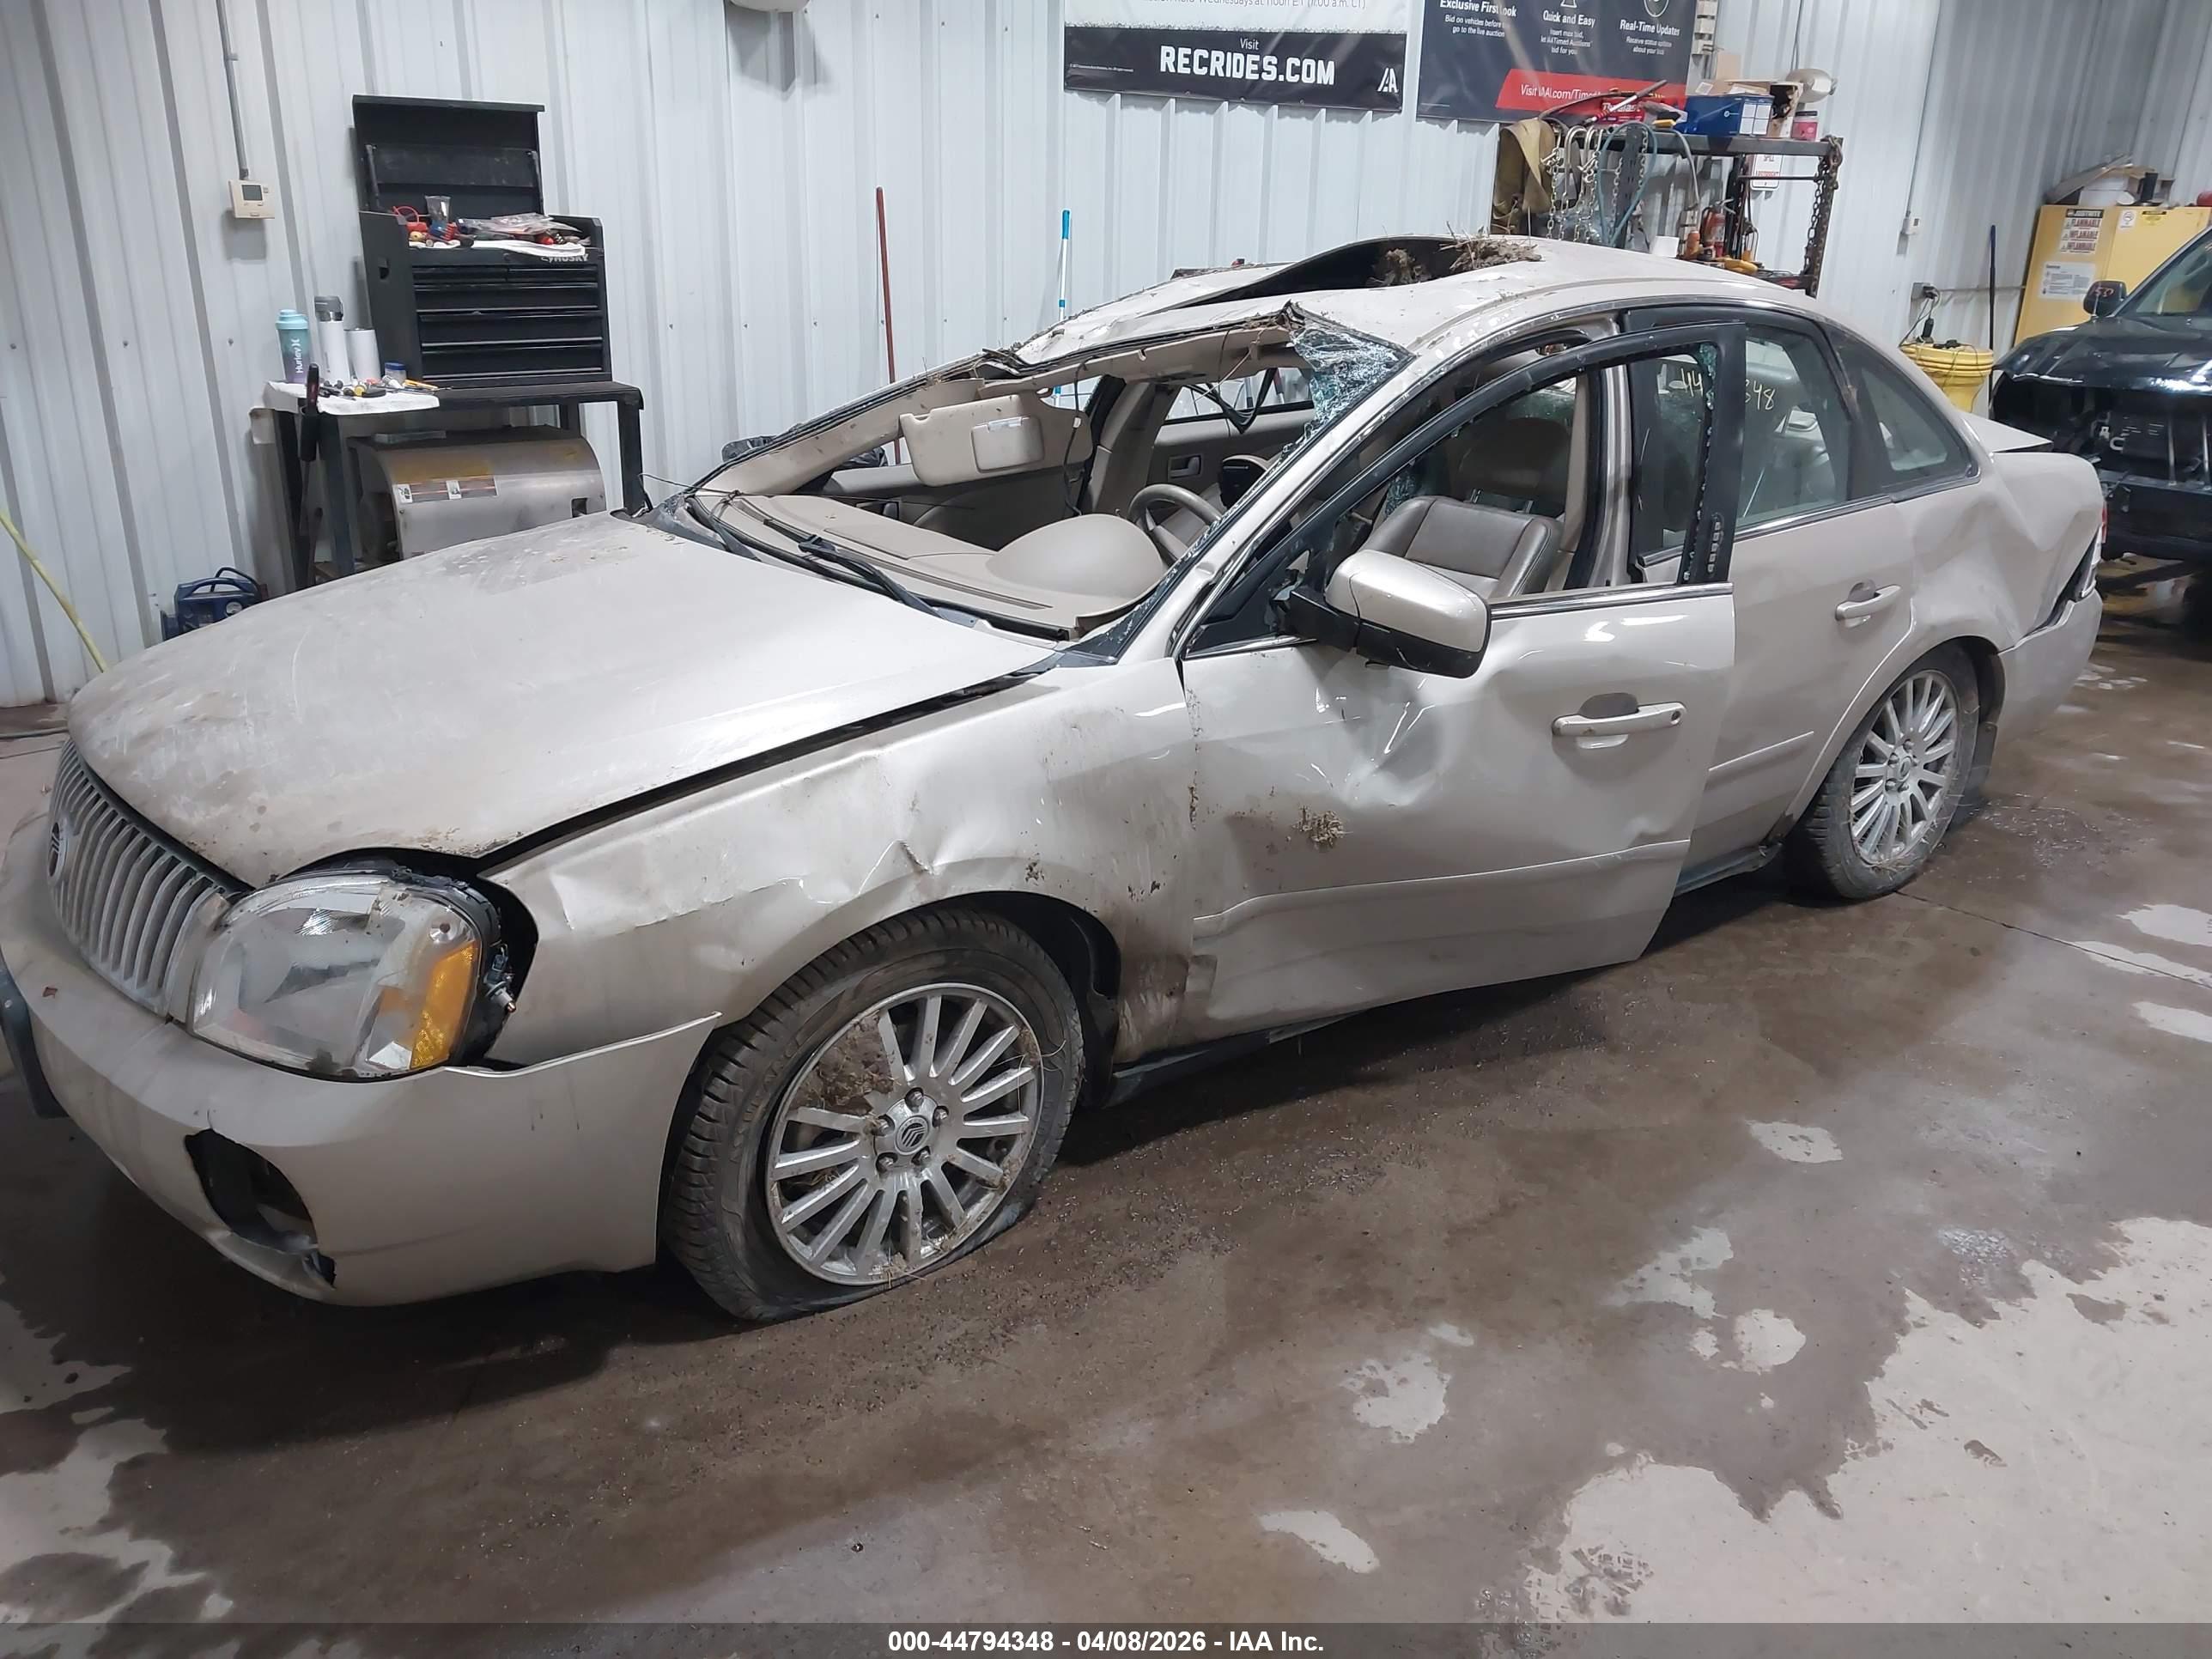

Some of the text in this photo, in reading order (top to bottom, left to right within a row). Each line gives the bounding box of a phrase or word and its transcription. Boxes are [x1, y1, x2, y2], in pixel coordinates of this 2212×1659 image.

[1440, 0, 1480, 12] Exclusive
[1481, 1, 1499, 14] First
[1543, 10, 1595, 27] Quick and Easy
[1620, 19, 1680, 36] Real-Time Updates
[1240, 38, 1260, 50] Visit
[1160, 45, 1335, 86] RECRIDES.COM
[1521, 84, 1537, 97] Visit
[292, 347, 304, 374] Hurley
